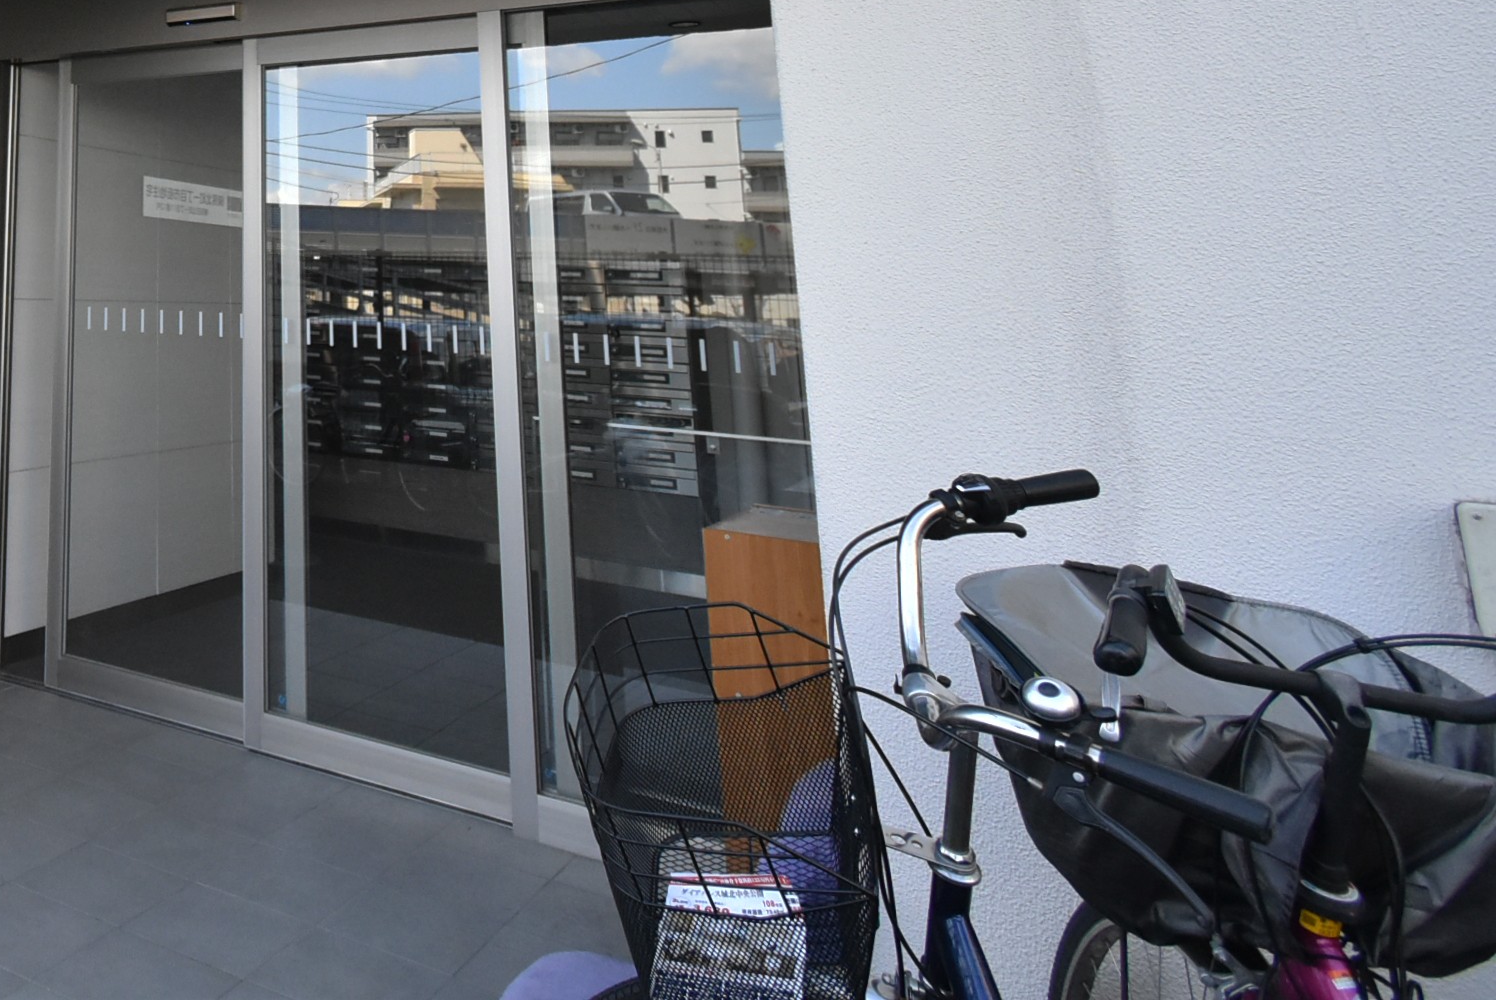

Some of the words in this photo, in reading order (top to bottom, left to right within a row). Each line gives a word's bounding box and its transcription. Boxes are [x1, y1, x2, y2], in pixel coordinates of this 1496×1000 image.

[682, 888, 764, 898] ダイアス城北中央公園
